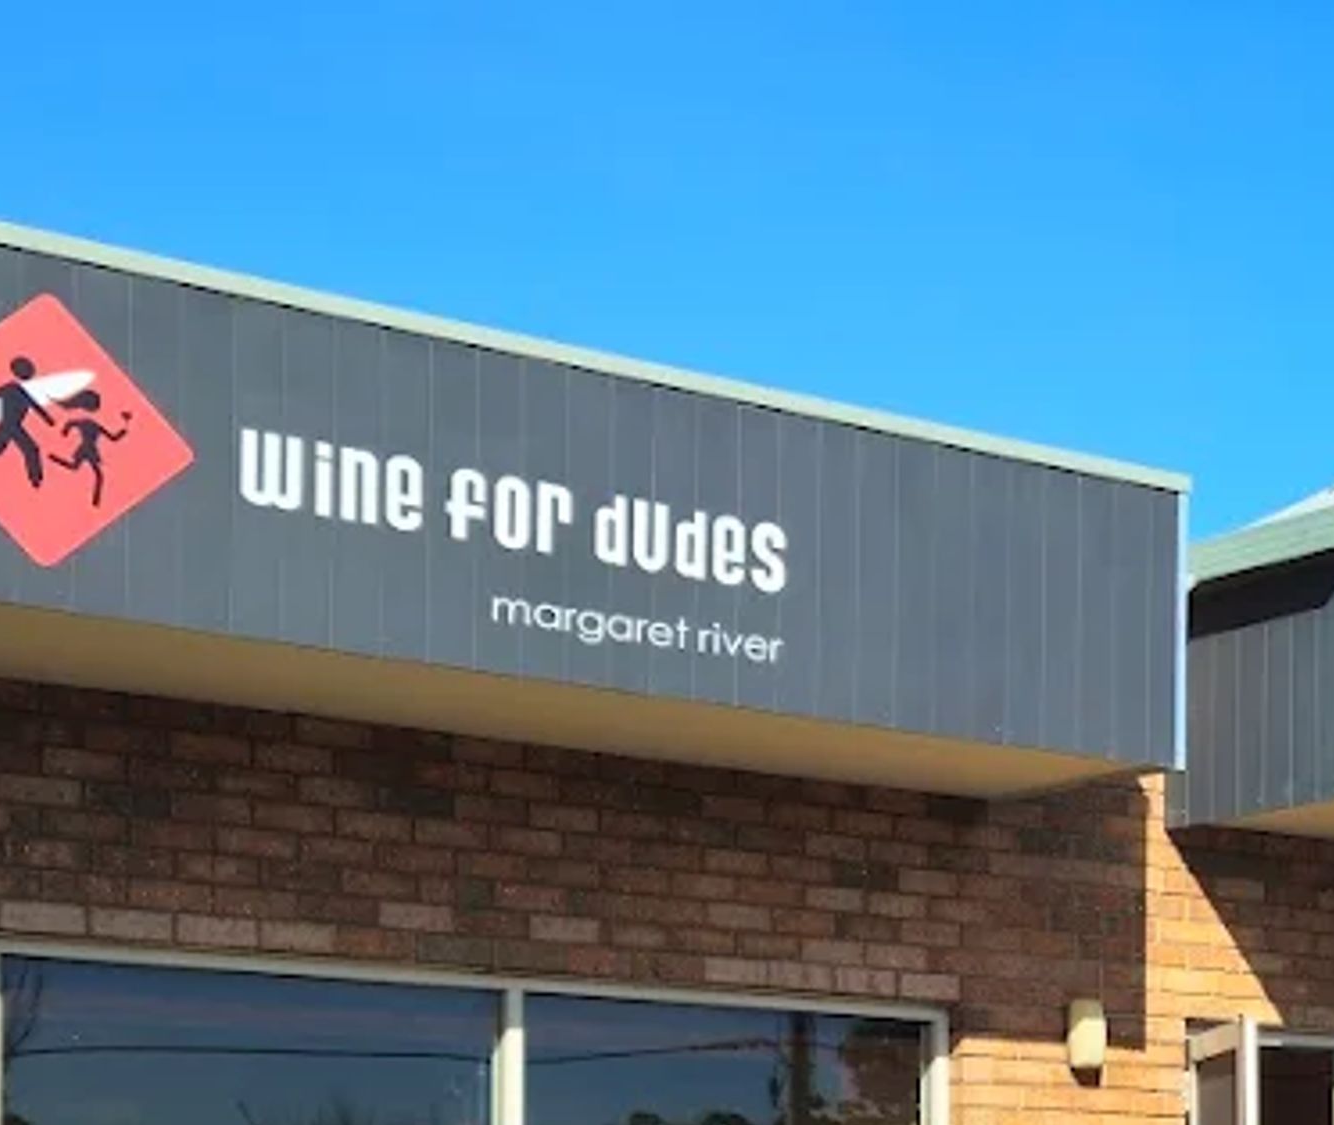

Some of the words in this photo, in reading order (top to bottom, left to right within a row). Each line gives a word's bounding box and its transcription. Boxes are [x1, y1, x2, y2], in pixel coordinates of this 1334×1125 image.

[444, 467, 574, 554] for
[490, 593, 691, 650] margaret
[696, 620, 786, 664] river
